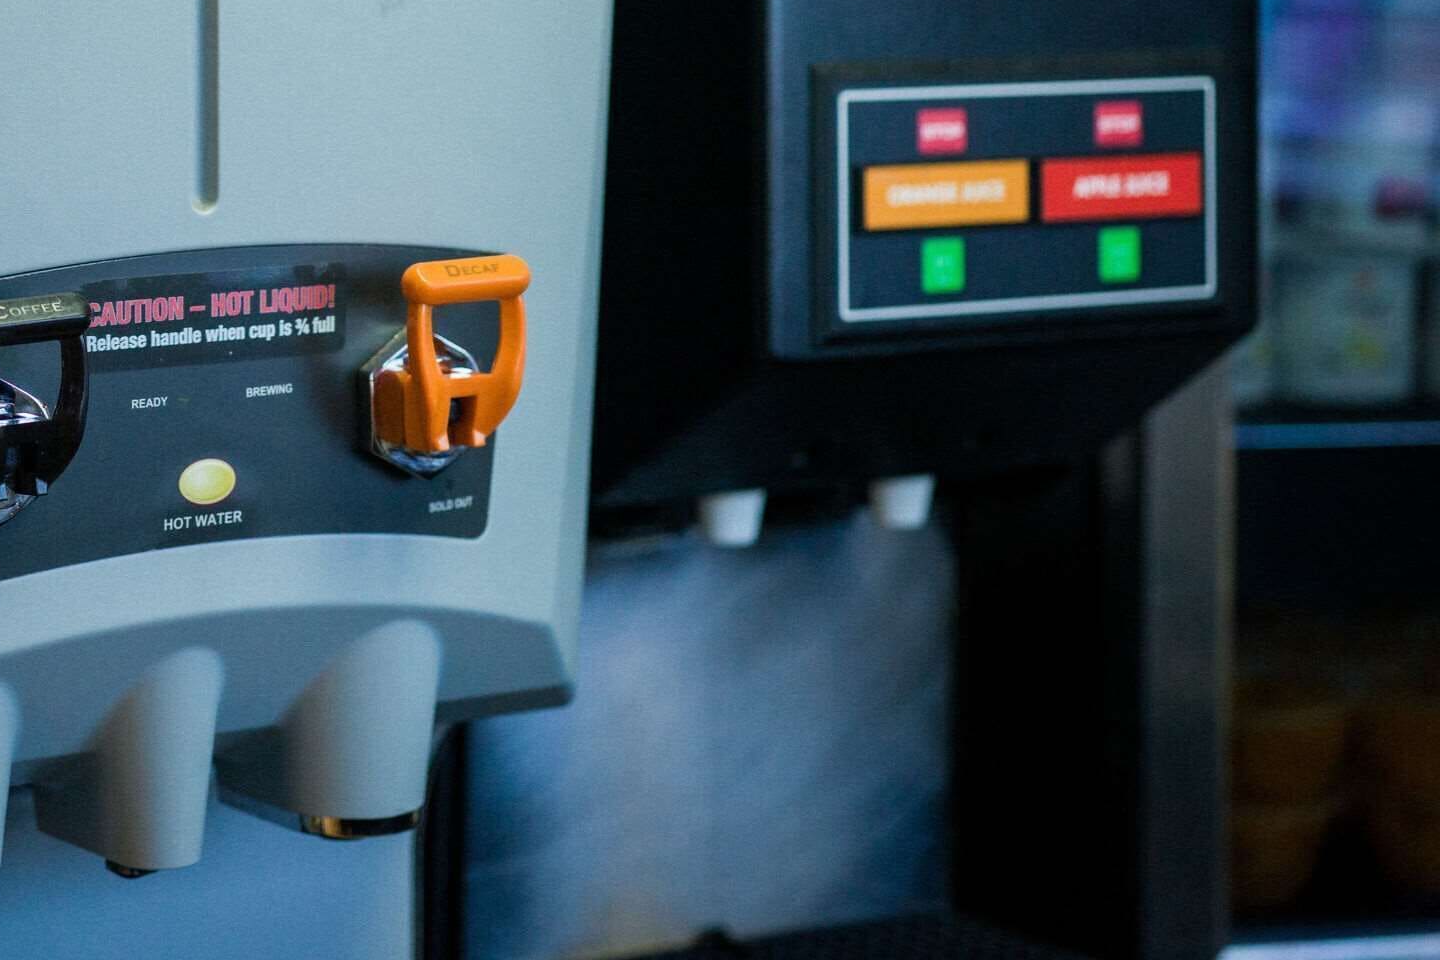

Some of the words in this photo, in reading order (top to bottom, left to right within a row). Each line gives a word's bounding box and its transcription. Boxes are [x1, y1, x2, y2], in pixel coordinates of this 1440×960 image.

[89, 296, 185, 328] CAUTION
[211, 291, 255, 318] HOT
[259, 284, 336, 315] LIQUID!
[86, 334, 147, 353] Release
[151, 327, 203, 348] handle
[206, 321, 245, 342] when
[248, 325, 276, 343] cup
[279, 318, 293, 337] is
[312, 315, 336, 335] full
[245, 383, 294, 398] BREWING
[131, 396, 169, 409] READY
[429, 499, 454, 514] SOLD
[455, 496, 473, 509] OUT
[163, 516, 192, 531] HOT
[195, 510, 242, 527] WATER
